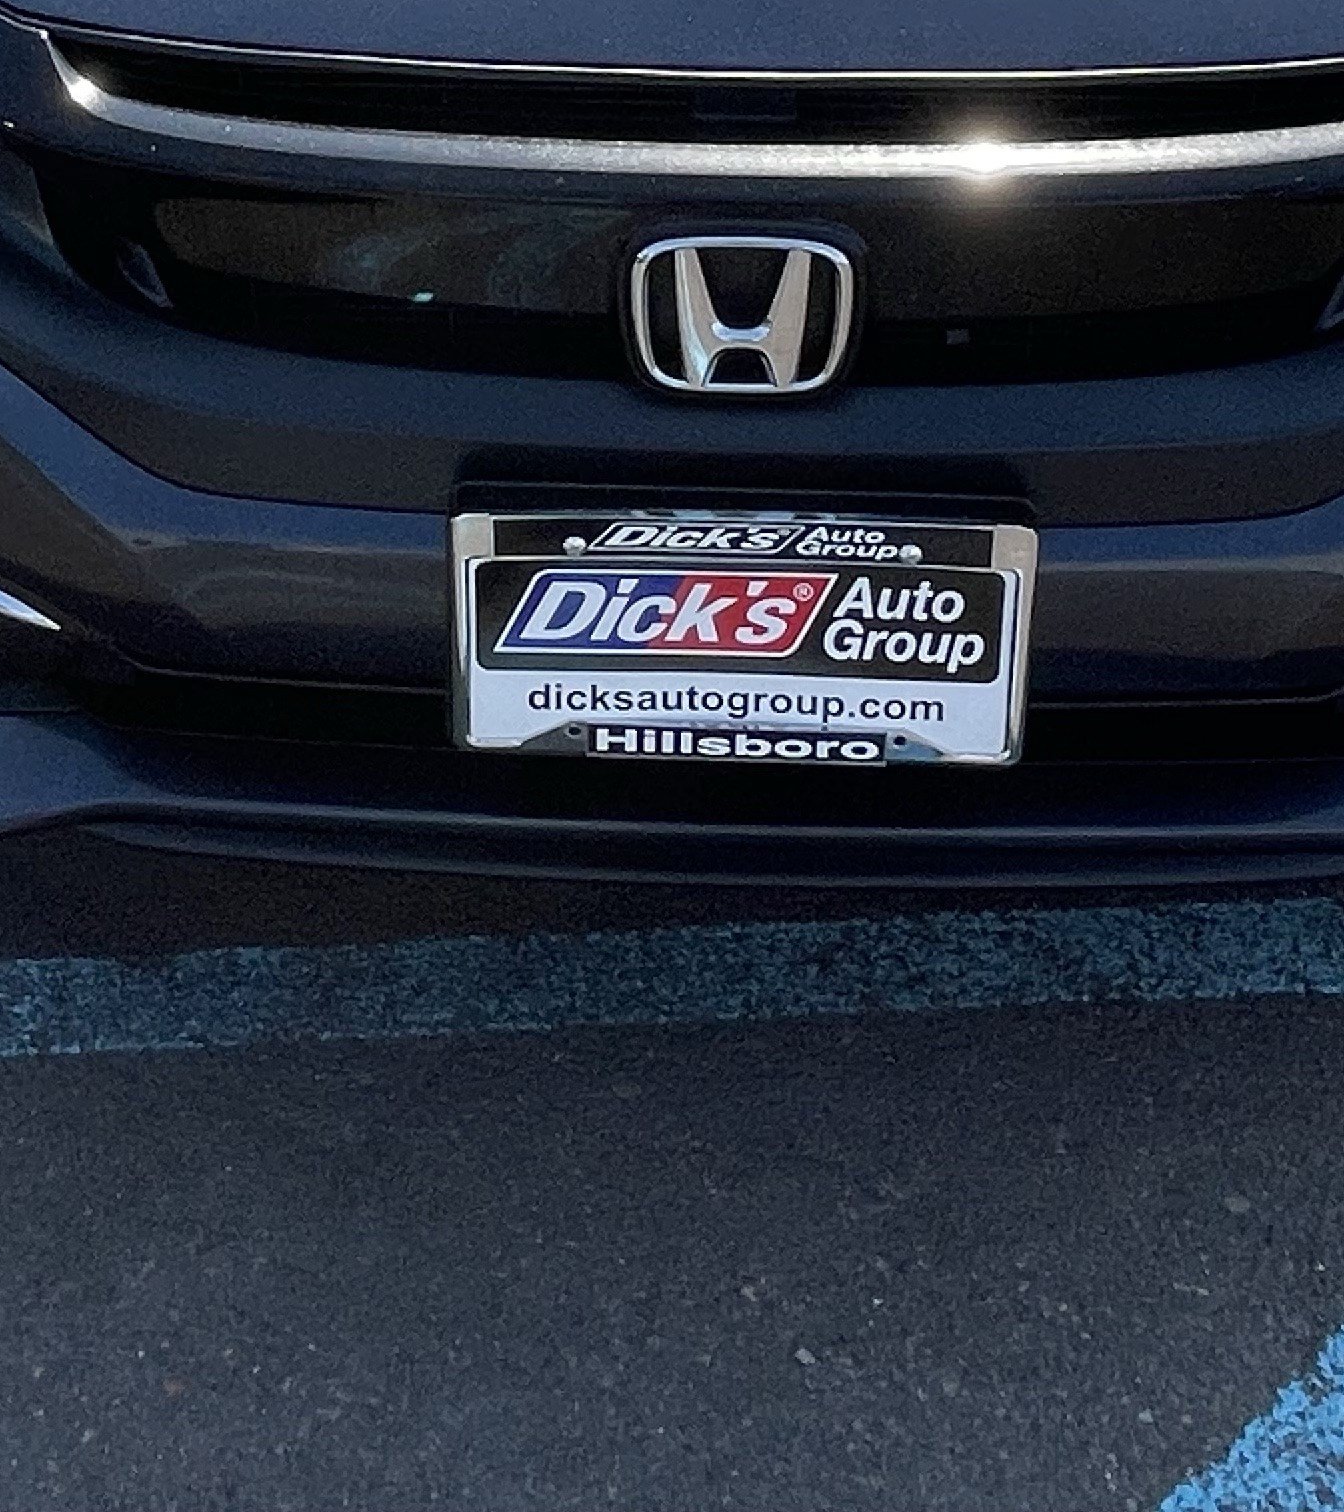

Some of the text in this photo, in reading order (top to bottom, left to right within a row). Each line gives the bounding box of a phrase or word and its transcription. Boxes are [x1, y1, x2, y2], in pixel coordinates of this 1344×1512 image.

[796, 540, 898, 561] Group
[804, 524, 886, 545] Auto
[833, 576, 965, 623] Auto
[822, 618, 985, 673] Group
[527, 683, 945, 724] dicksautogroup.com
[595, 727, 881, 761] Hillsboro
